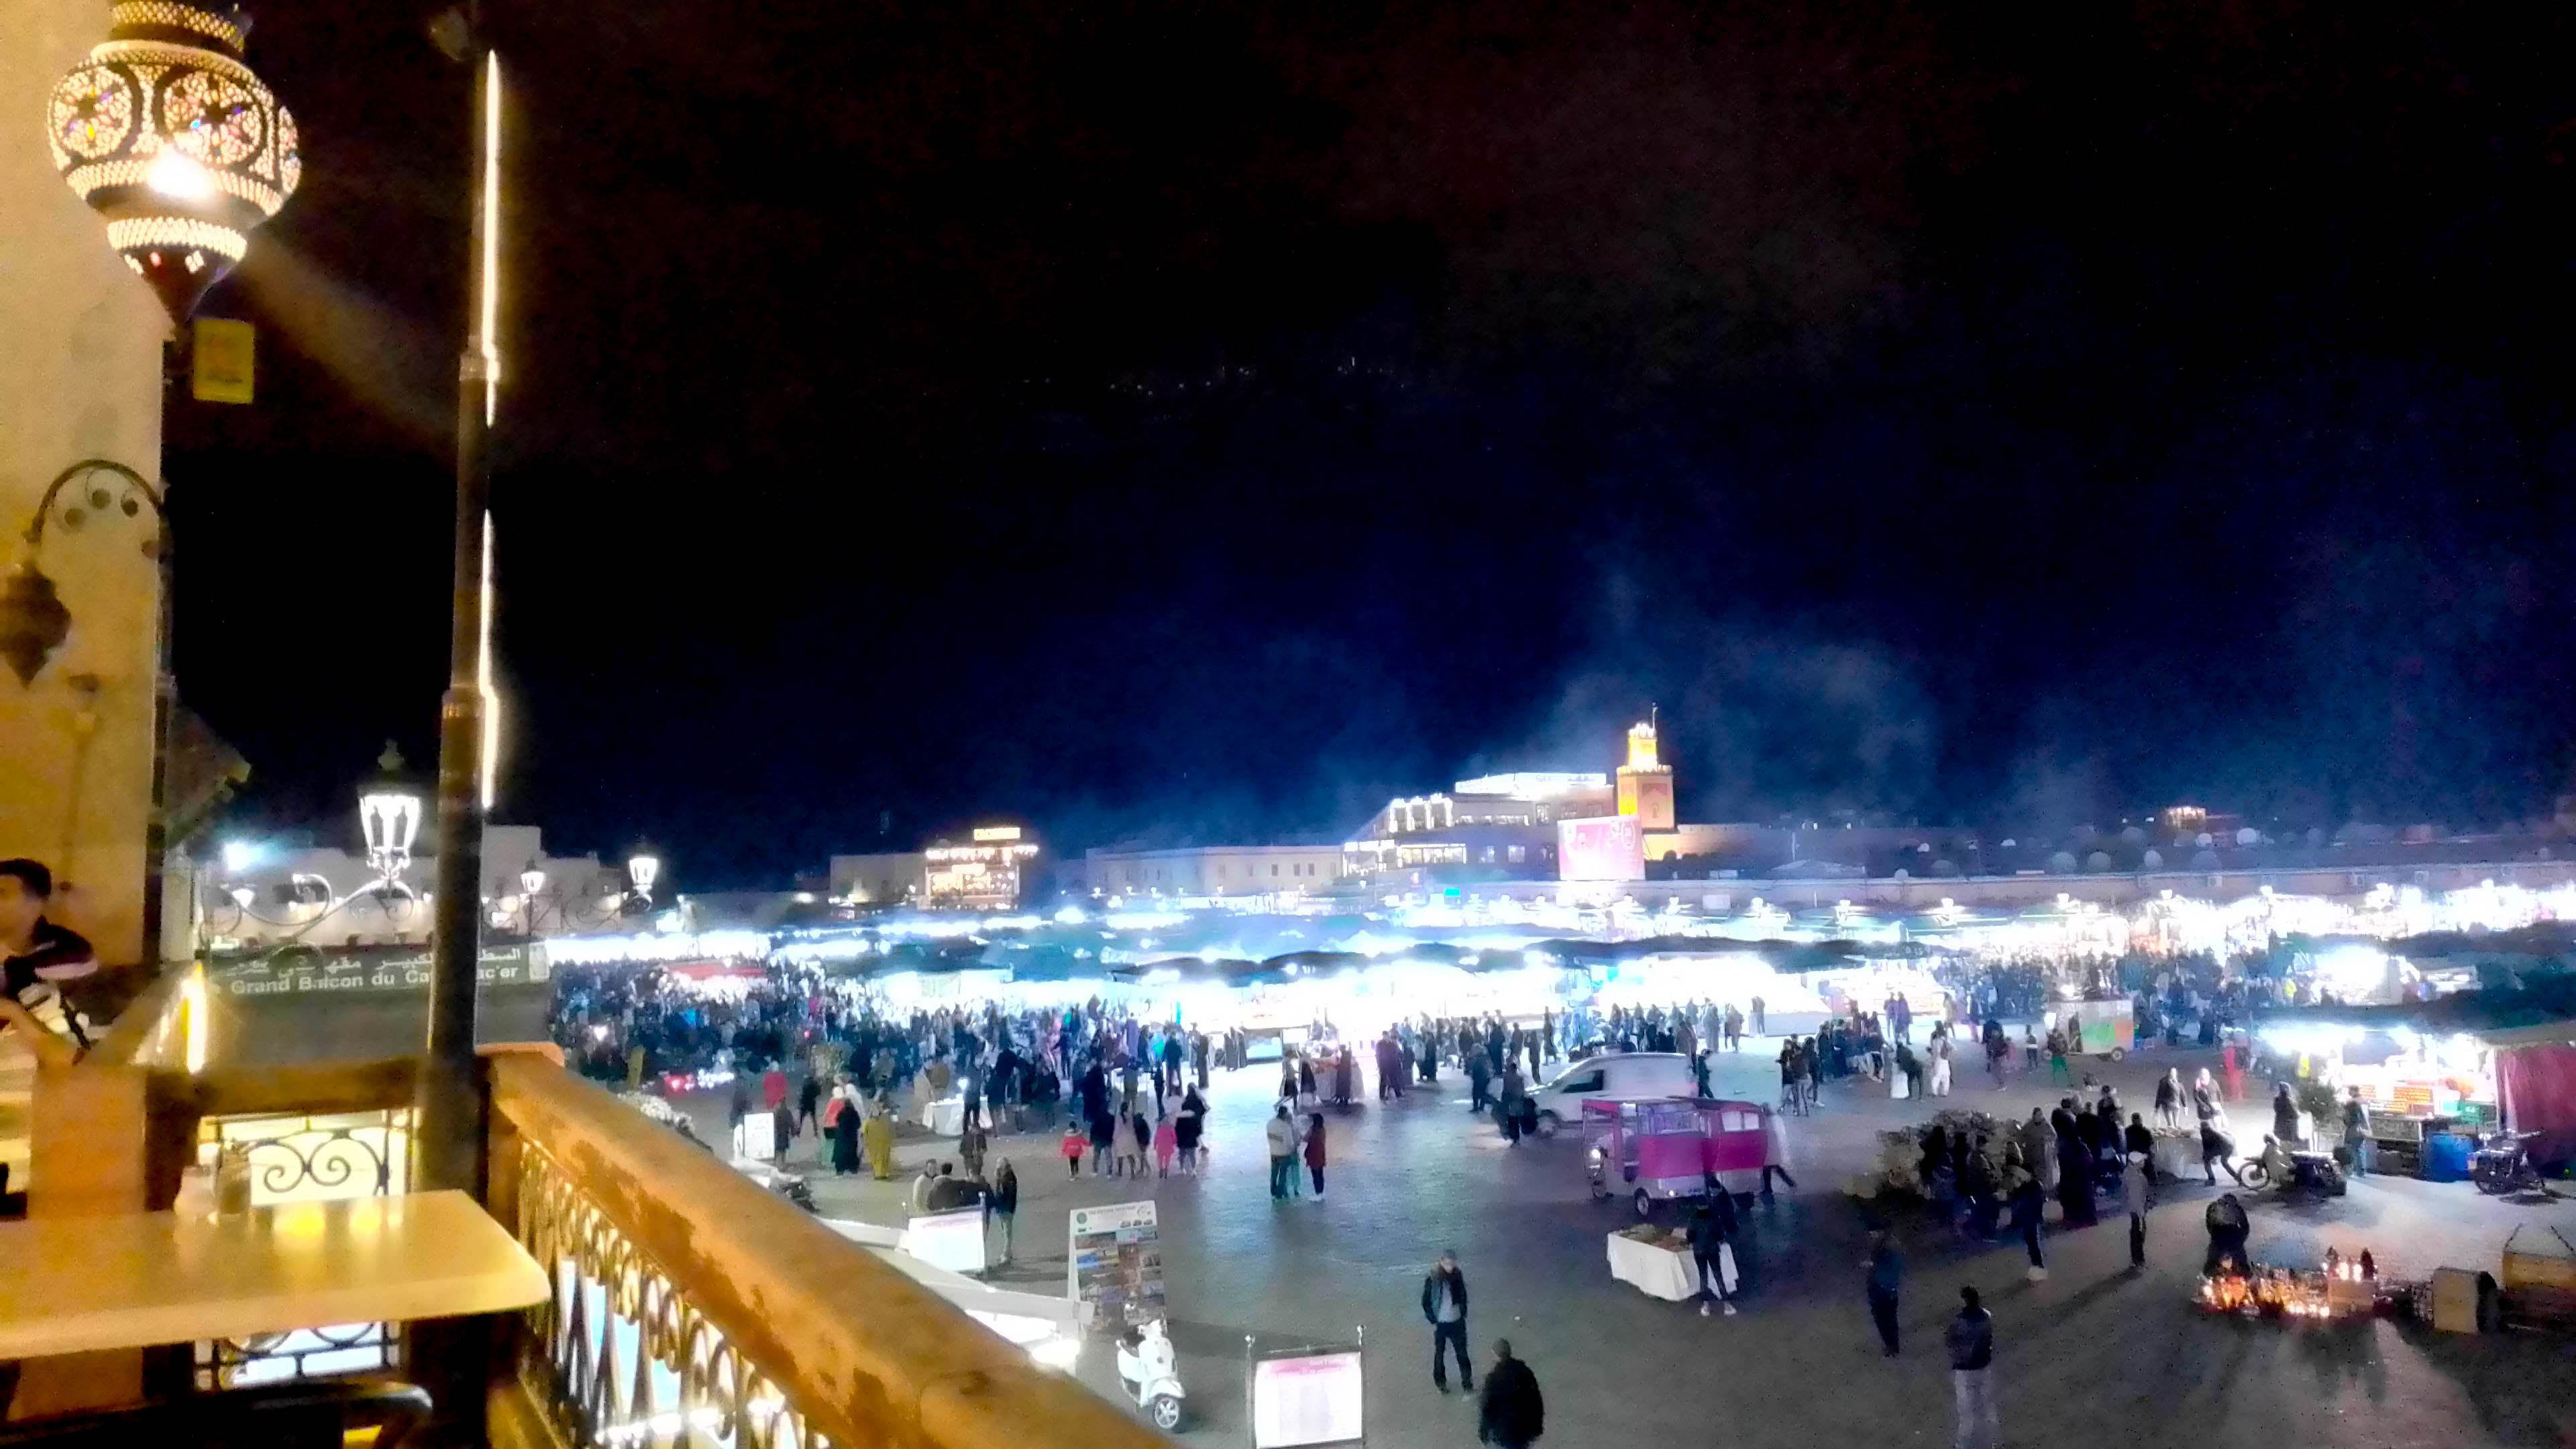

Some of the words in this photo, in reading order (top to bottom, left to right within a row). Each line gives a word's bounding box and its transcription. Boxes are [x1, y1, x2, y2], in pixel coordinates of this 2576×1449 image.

[230, 977, 290, 994] Grand
[371, 972, 395, 986] du
[405, 970, 431, 983] Ca
